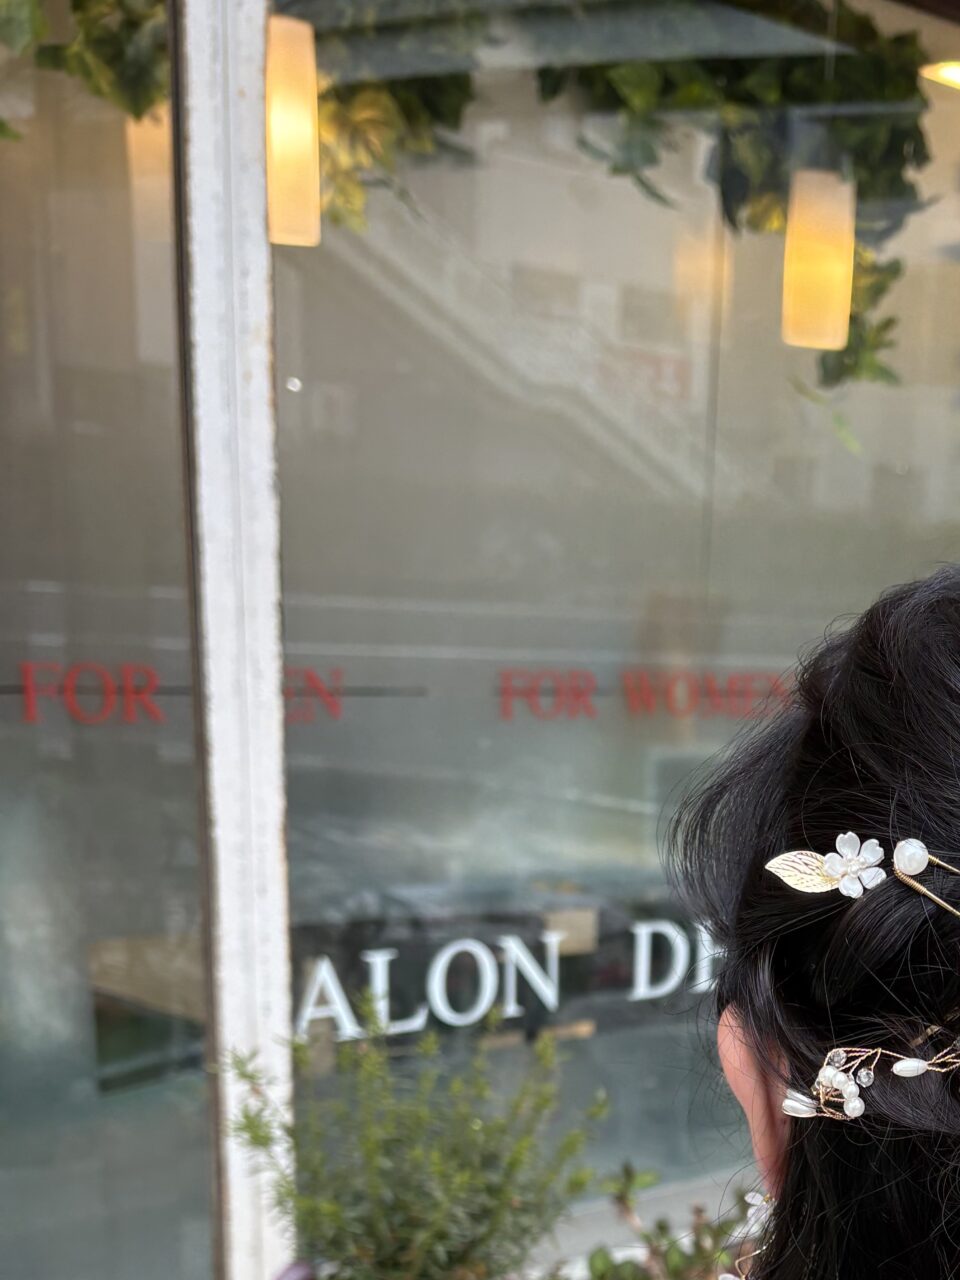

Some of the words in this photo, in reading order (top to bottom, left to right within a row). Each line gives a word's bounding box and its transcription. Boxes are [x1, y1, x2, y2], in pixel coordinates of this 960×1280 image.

[18, 660, 167, 725] FOR
[499, 666, 598, 721] FOR
[296, 930, 567, 1042] ALON
